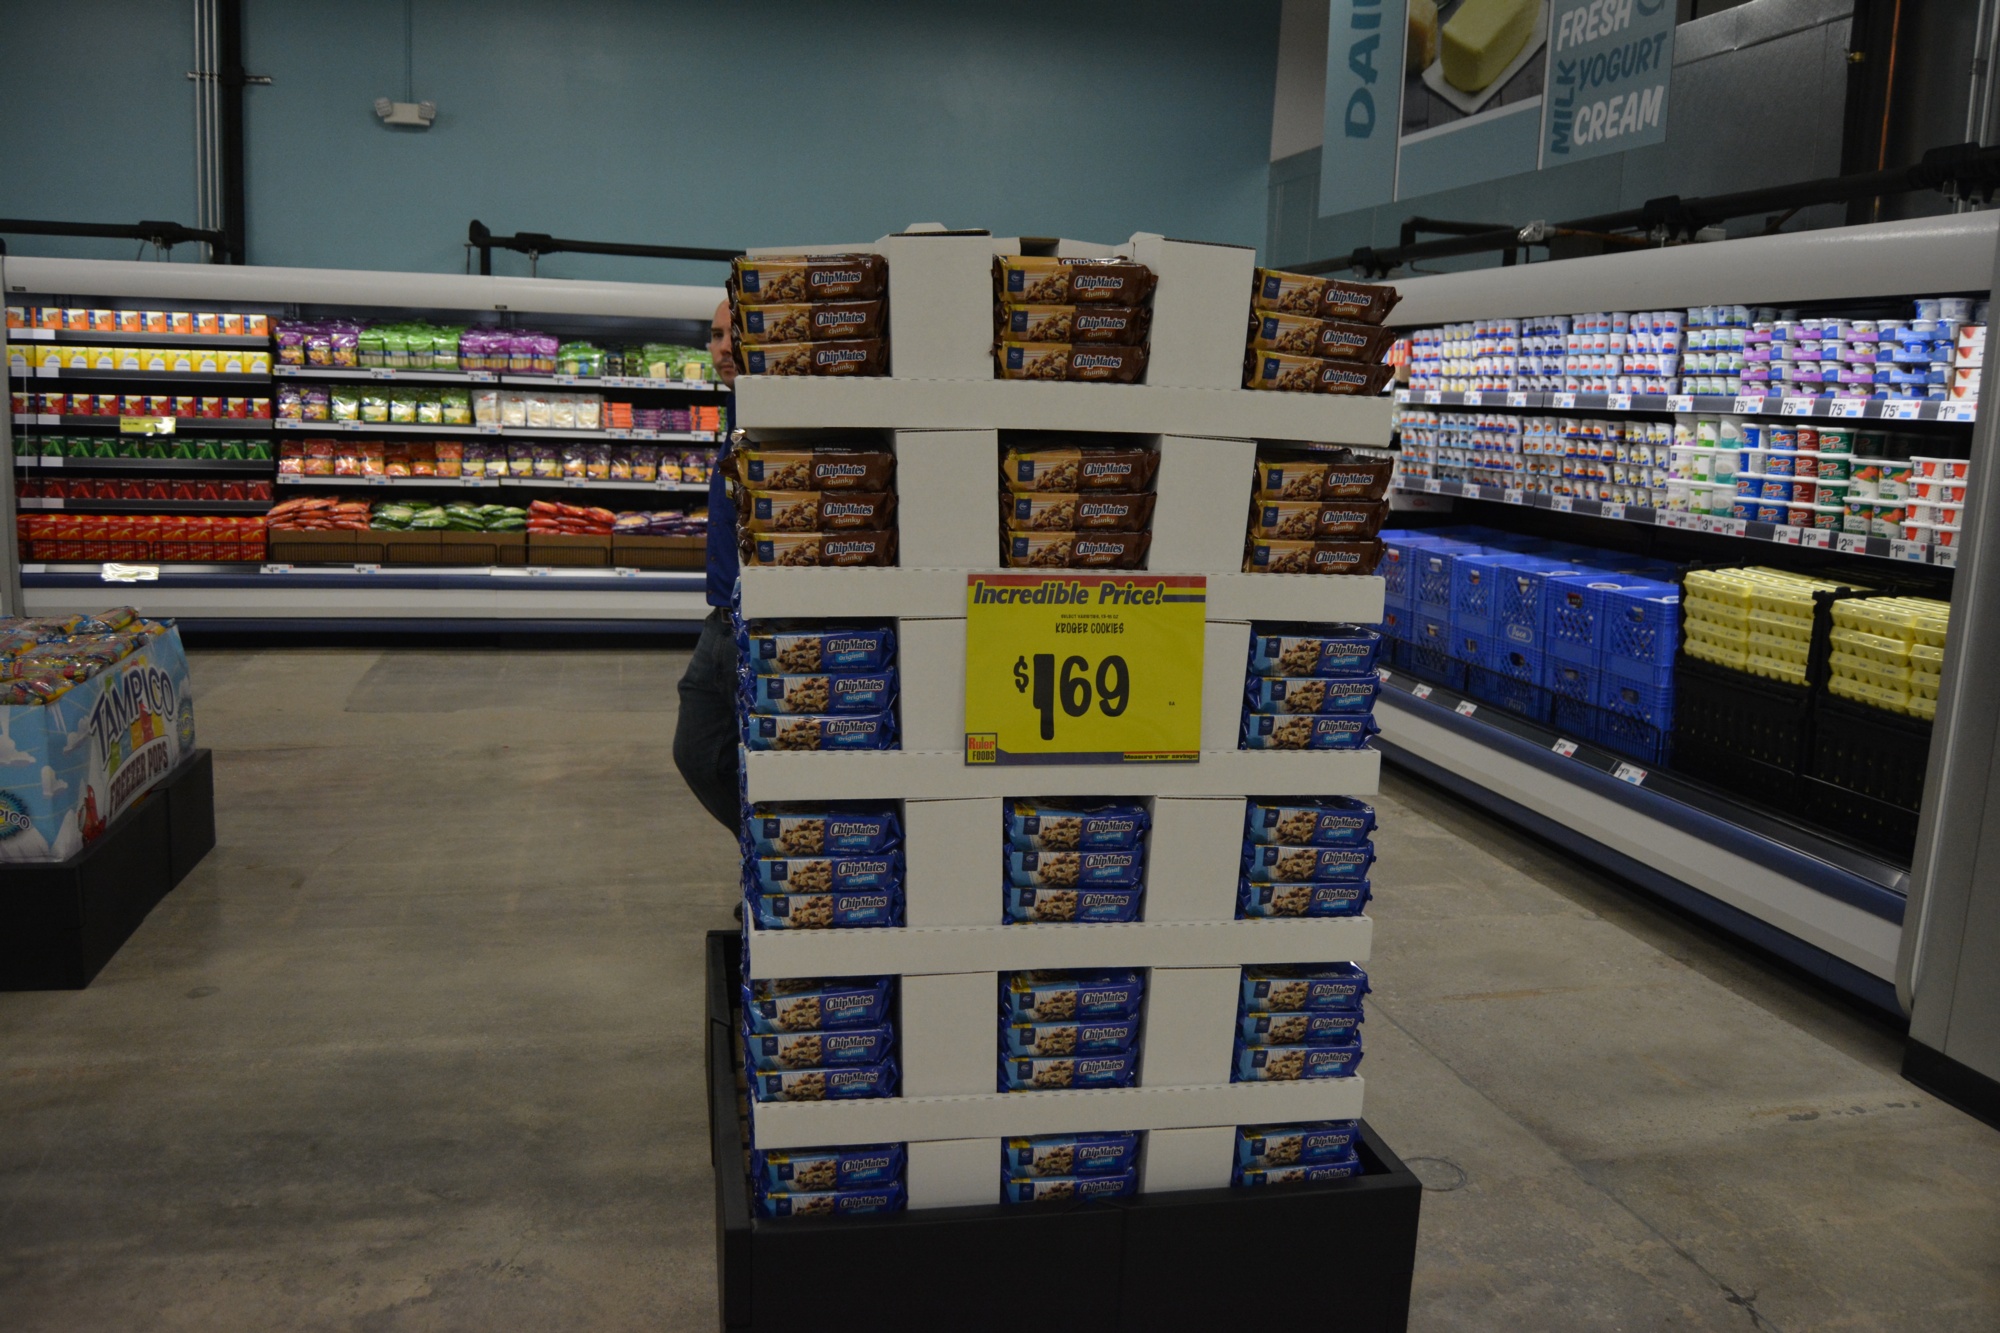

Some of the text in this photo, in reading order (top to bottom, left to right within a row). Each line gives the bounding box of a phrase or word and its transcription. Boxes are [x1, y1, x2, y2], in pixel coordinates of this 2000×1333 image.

[1557, 0, 1632, 51] FRESH
[1578, 31, 1668, 91] YOGURT
[1551, 58, 1577, 154] MILK
[1573, 85, 1665, 146] CREAM
[811, 271, 861, 286] ChipMates
[1075, 276, 1123, 290] ChipMates
[824, 285, 850, 294] chunky
[1085, 290, 1110, 298] chunky
[1326, 289, 1371, 306] ChipMates
[816, 312, 865, 327] ChipMates
[1077, 316, 1126, 330] ChipMates
[829, 326, 854, 334] chunky
[1322, 330, 1367, 346] ChipMates
[817, 350, 866, 365] ChipMates
[1073, 354, 1122, 369] ChipMates
[830, 364, 854, 372] chunky
[1322, 368, 1367, 385] ChipMates
[816, 464, 866, 478] ChipMates
[1083, 463, 1132, 477] ChipMates
[1328, 473, 1374, 487] ChipMates
[823, 503, 874, 517] ChipMates
[1080, 503, 1128, 518] ChipMates
[835, 517, 860, 525] chunky
[1322, 510, 1367, 525] ChipMates
[826, 541, 876, 556] ChipMates
[1076, 541, 1124, 556] ChipMates
[1315, 550, 1360, 565] ChipMates
[974, 581, 1164, 604] Incredible Price!
[1055, 622, 1124, 634] KROGER COOKIES
[827, 639, 877, 653] ChipMates
[1326, 644, 1370, 657] ChipMates
[839, 652, 865, 661] original
[835, 680, 884, 693] ChipMates
[1330, 683, 1373, 696] ChipMates
[846, 693, 872, 701] original
[90, 668, 174, 767] TAMPICO
[827, 721, 877, 735] ChipMates
[1318, 719, 1361, 733] ChipMates
[838, 733, 864, 742] original
[968, 736, 995, 750] Ruler
[972, 750, 995, 761] FOODS
[110, 740, 168, 814] FREEZER POPS
[830, 823, 880, 836] ChipMates
[1087, 820, 1133, 832] ChipMates
[1321, 816, 1364, 829] ChipMates
[1086, 854, 1132, 868] ChipMates
[1322, 851, 1365, 865] ChipMates
[838, 862, 886, 876] ChipMates
[849, 875, 875, 884] original
[1083, 894, 1129, 906] ChipMates
[1316, 889, 1359, 901] ChipMates
[839, 897, 887, 911] ChipMates
[850, 910, 875, 918] original
[1313, 984, 1356, 996] ChipMates
[826, 995, 873, 1010] ChipMates
[1082, 992, 1128, 1004] ChipMates
[1312, 1018, 1354, 1029] ChipMates
[1082, 1028, 1128, 1041] ChipMates
[827, 1036, 875, 1049] ChipMates
[1309, 1052, 1352, 1064] ChipMates
[1080, 1060, 1124, 1074] ChipMates
[831, 1072, 878, 1086] ChipMates
[1079, 1145, 1123, 1159] ChipMates
[842, 1158, 889, 1172] ChipMates
[840, 1196, 886, 1208] ChipMates
